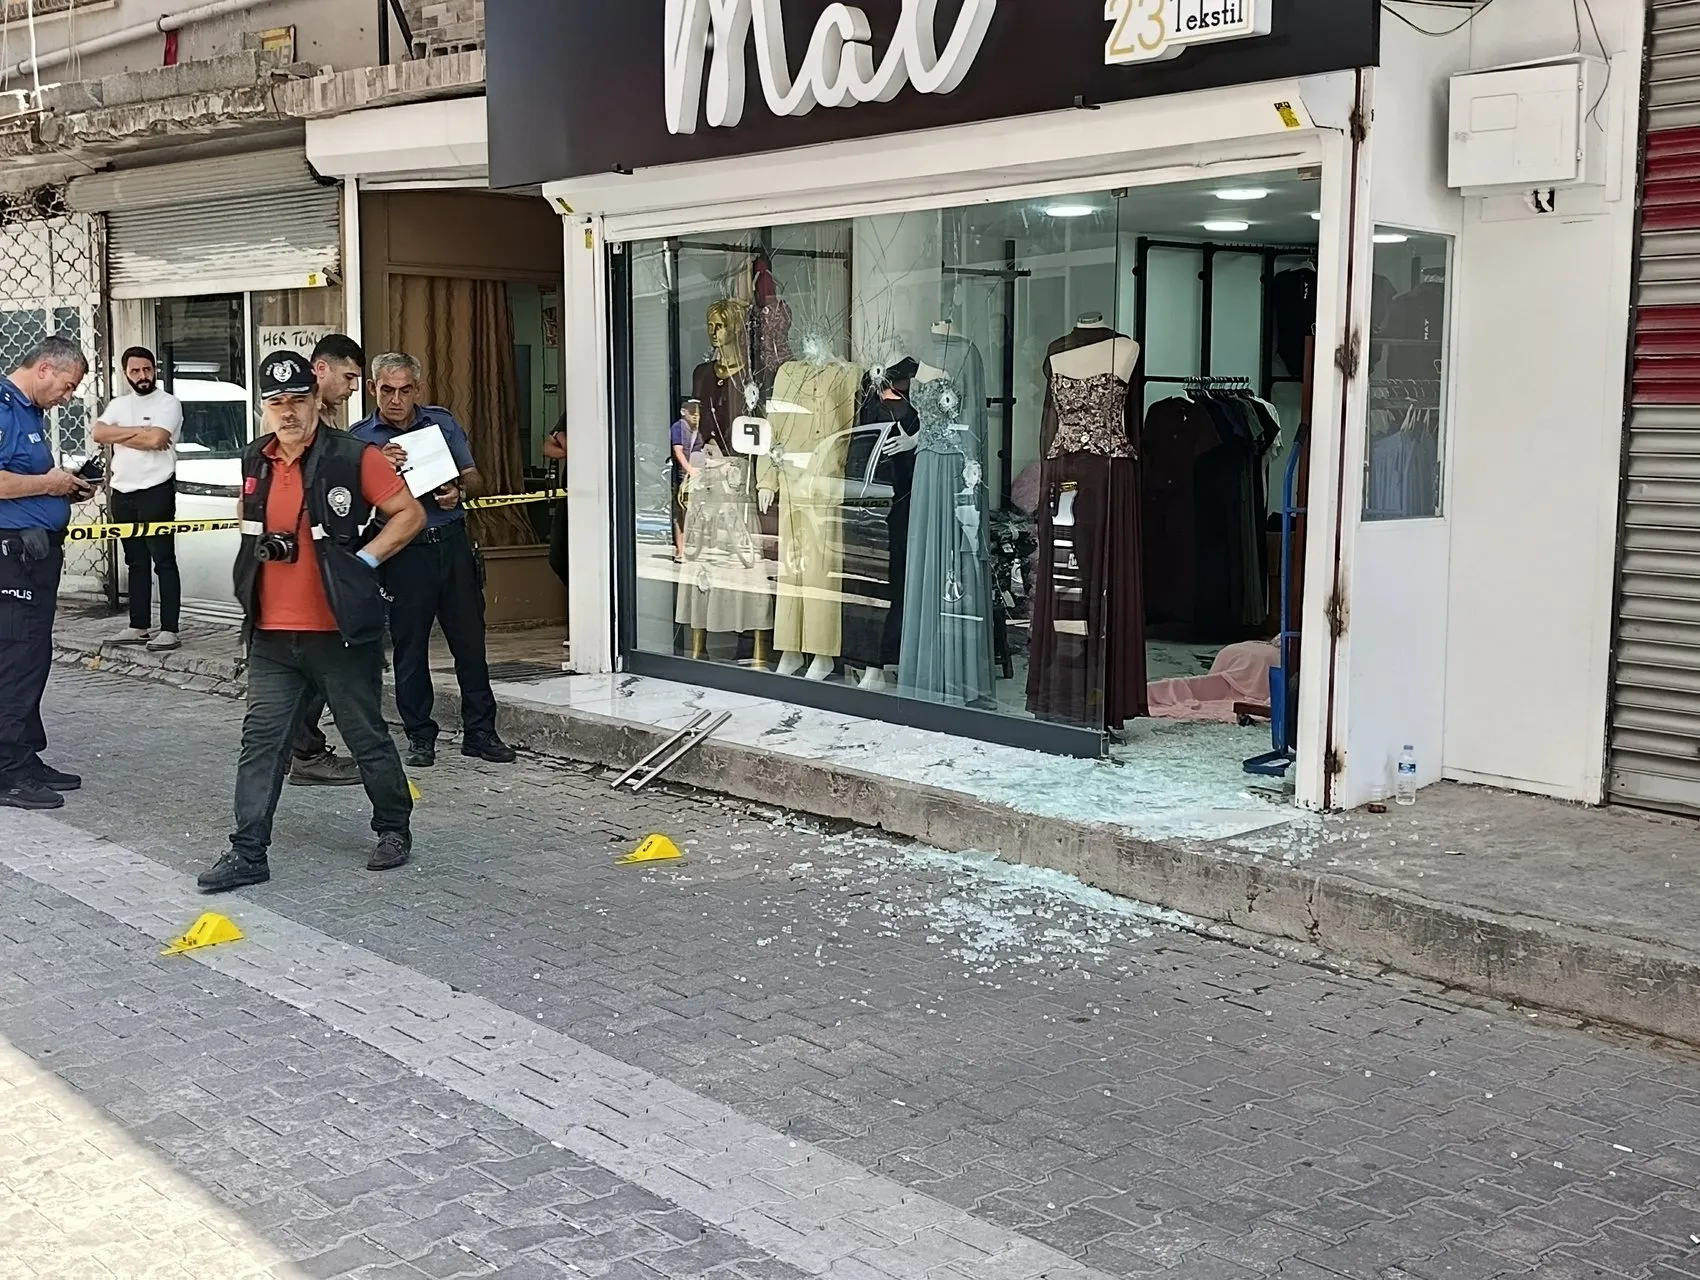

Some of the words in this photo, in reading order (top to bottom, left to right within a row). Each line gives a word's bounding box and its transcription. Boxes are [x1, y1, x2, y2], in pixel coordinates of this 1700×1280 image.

[1109, 0, 1166, 56] 23
[1169, 0, 1243, 33] Tekstil
[263, 332, 287, 347] HER
[66, 527, 121, 541] OLİS
